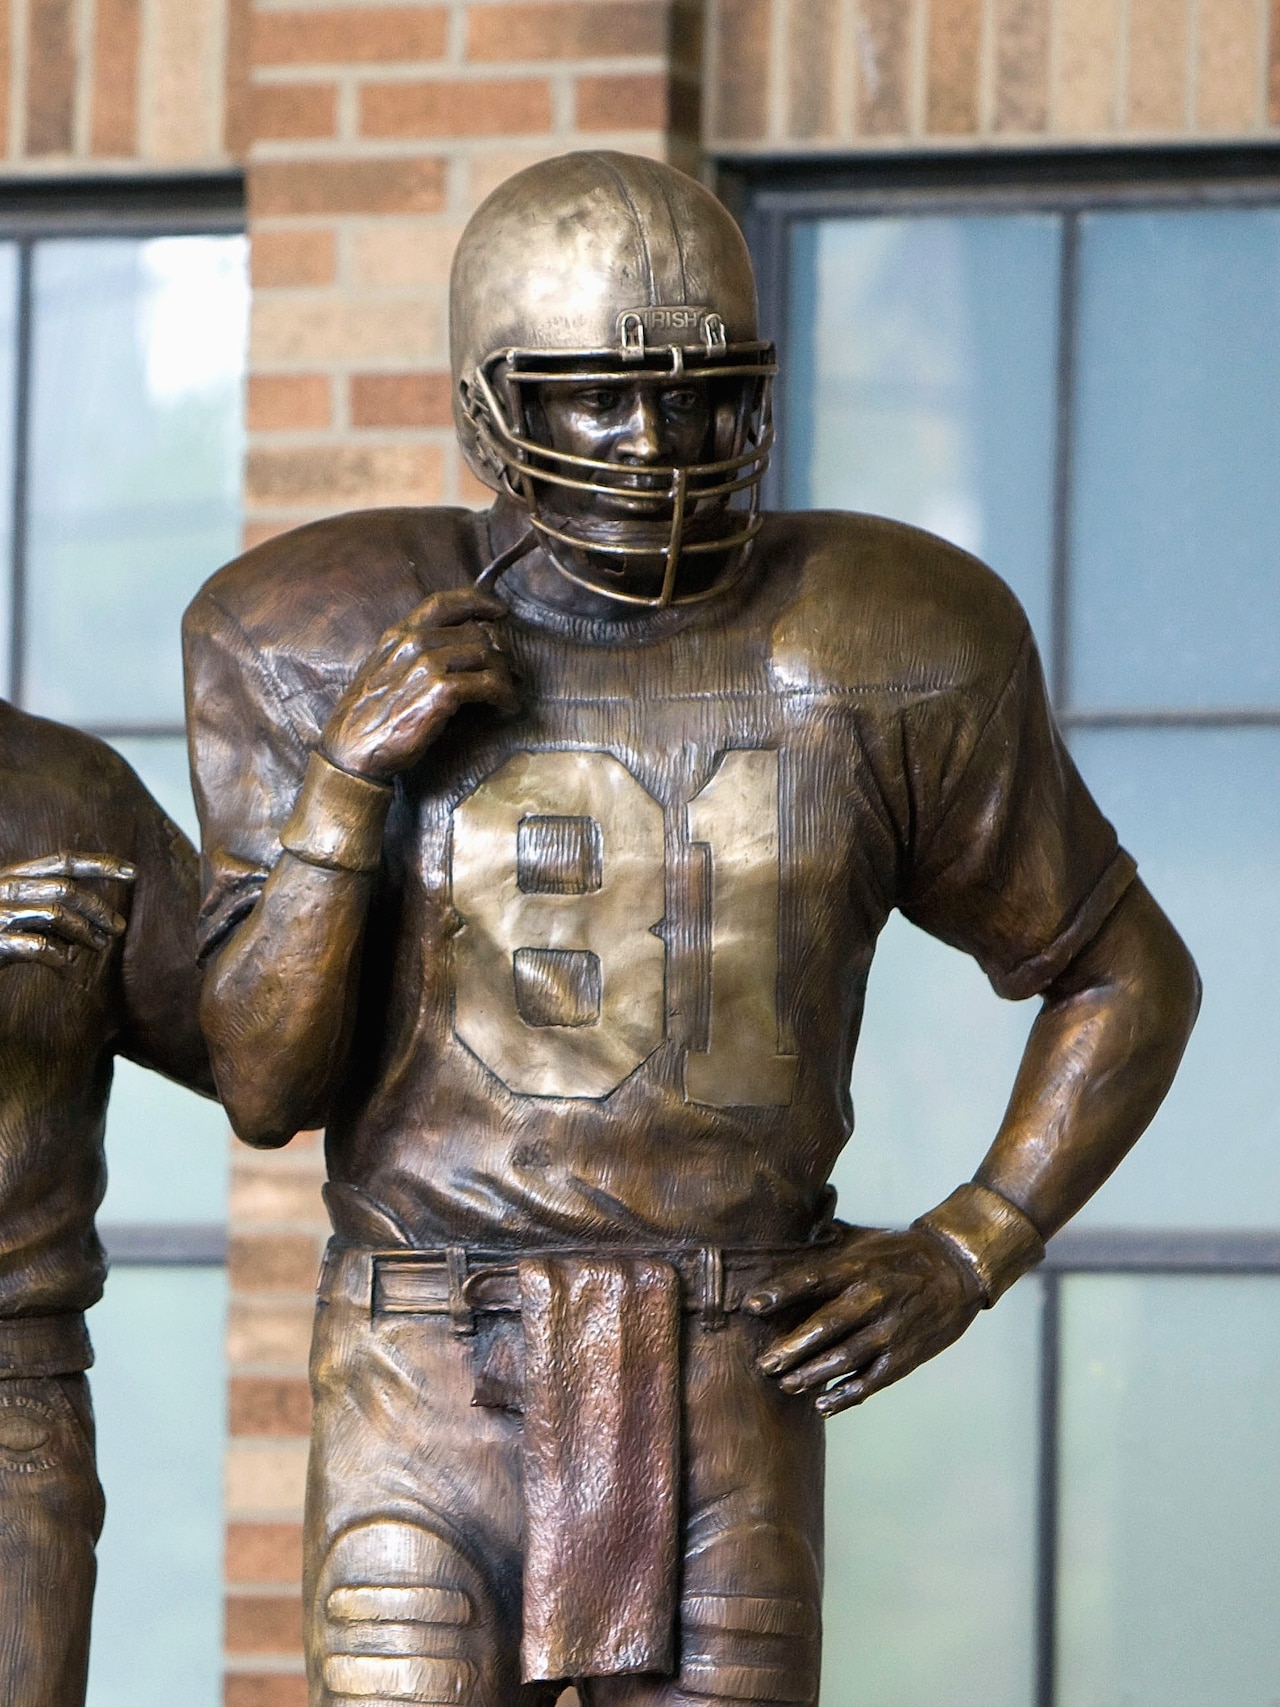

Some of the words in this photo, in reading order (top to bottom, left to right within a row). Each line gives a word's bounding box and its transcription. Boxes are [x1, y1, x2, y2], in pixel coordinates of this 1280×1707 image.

[644, 311, 698, 329] IRISH
[450, 749, 799, 1106] 81
[16, 1396, 57, 1420] DAME
